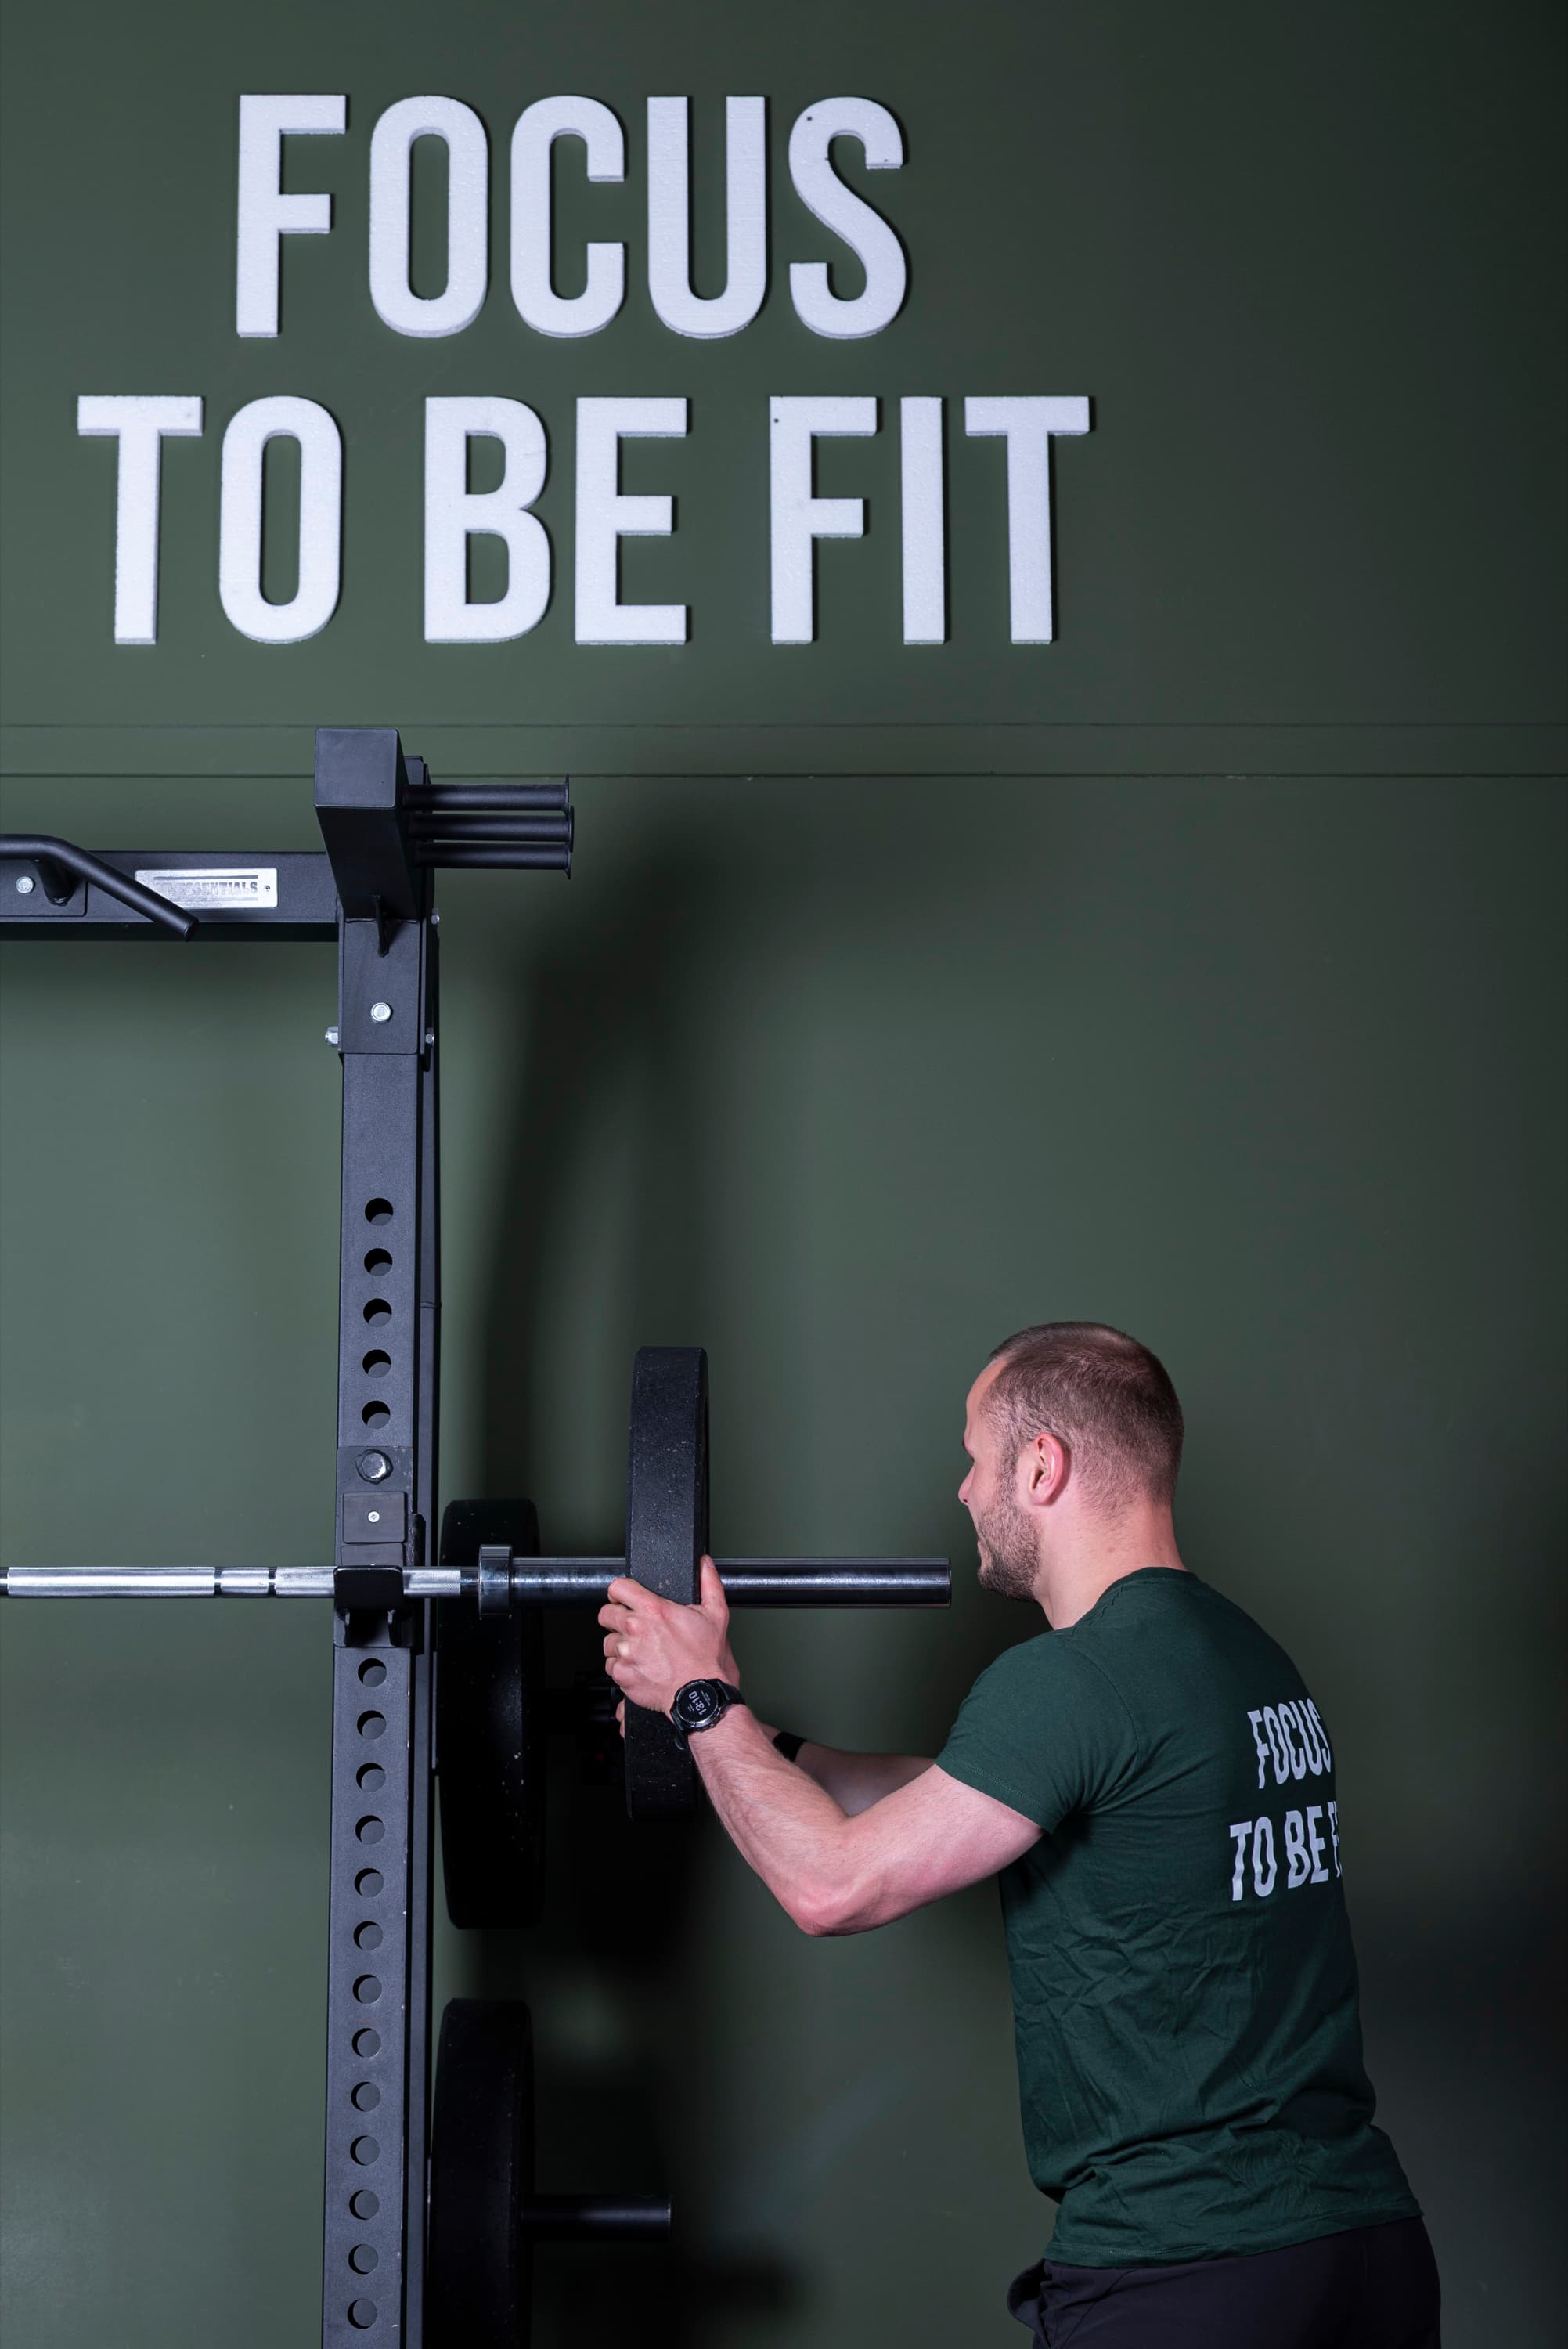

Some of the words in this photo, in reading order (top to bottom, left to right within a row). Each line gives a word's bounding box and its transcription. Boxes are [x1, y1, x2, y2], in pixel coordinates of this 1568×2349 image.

[236, 94, 907, 340] FOCUS
[77, 395, 343, 646] TO
[424, 395, 689, 646] BE
[769, 395, 1092, 646] FIT
[689, 1690, 707, 1716] 13:10
[1246, 1698, 1332, 1789] FOCUS
[1229, 1816, 1278, 1902] TO
[1284, 1805, 1329, 1889] BE
